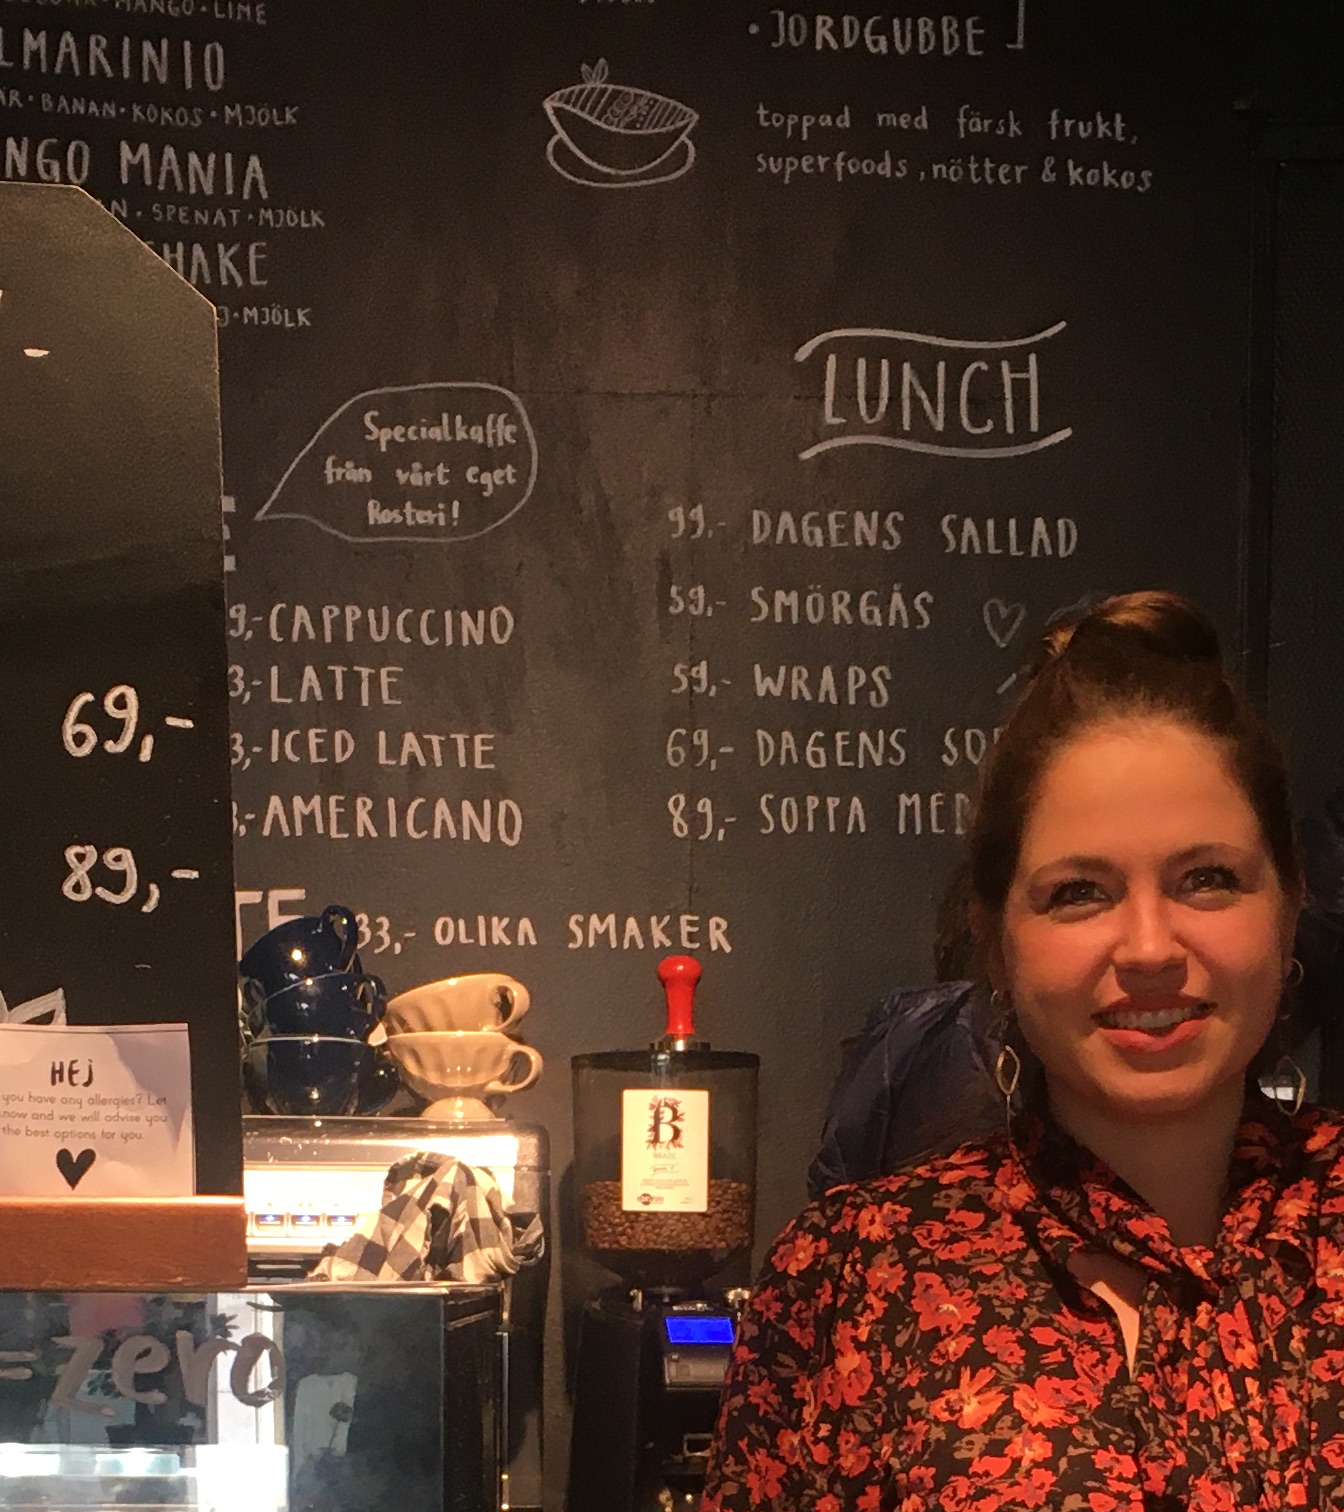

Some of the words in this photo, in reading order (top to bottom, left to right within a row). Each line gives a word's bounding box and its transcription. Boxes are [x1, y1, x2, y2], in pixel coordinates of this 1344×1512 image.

[214, 1, 267, 25] LIME
[771, 11, 984, 56] JORDGUBBE
[41, 92, 117, 118] BANAN
[132, 101, 203, 127] KOKOS
[224, 104, 300, 126] MJÖLK
[757, 103, 851, 139] toppad
[877, 107, 929, 131] med
[957, 104, 1023, 138] färsk
[120, 139, 270, 200] MANIA
[1068, 159, 1153, 192] kokos
[152, 203, 241, 227] SPENAT
[258, 205, 326, 228] MJÖLK
[242, 306, 312, 328] MJÖLK
[824, 352, 1039, 436] LUNCH
[324, 455, 373, 485] från
[466, 463, 518, 497] eget
[752, 508, 904, 551] DAGENS
[941, 513, 1079, 559] SALLAD
[268, 602, 516, 647] CAPPUCCINO
[750, 583, 935, 630] SMÖRGÅS
[270, 665, 404, 707] LATTE
[754, 664, 893, 708] WRAPS
[60, 685, 195, 762] 69,-
[270, 728, 356, 764] ICED
[378, 730, 496, 770] LATTE
[665, 728, 735, 772] 69,-
[756, 728, 908, 769] DAGENS
[262, 794, 523, 847] AMERICANO
[666, 792, 738, 842] 89,-
[759, 793, 868, 835] SOPPA
[60, 844, 200, 913] 89,-
[434, 915, 537, 947] OLIKA
[567, 914, 733, 953] SMAKER
[2, 1092, 24, 1105] you
[28, 1091, 56, 1105] have
[60, 1095, 83, 1109] any
[87, 1093, 142, 1111] allergies?
[147, 1093, 167, 1105] Let
[31, 1109, 55, 1122] and
[58, 1113, 76, 1122] we
[81, 1110, 100, 1123] will
[104, 1110, 141, 1123] advise
[145, 1114, 168, 1128] you
[1, 1125, 21, 1137] the
[25, 1125, 50, 1138] best
[54, 1128, 96, 1142] options
[101, 1128, 117, 1140] for
